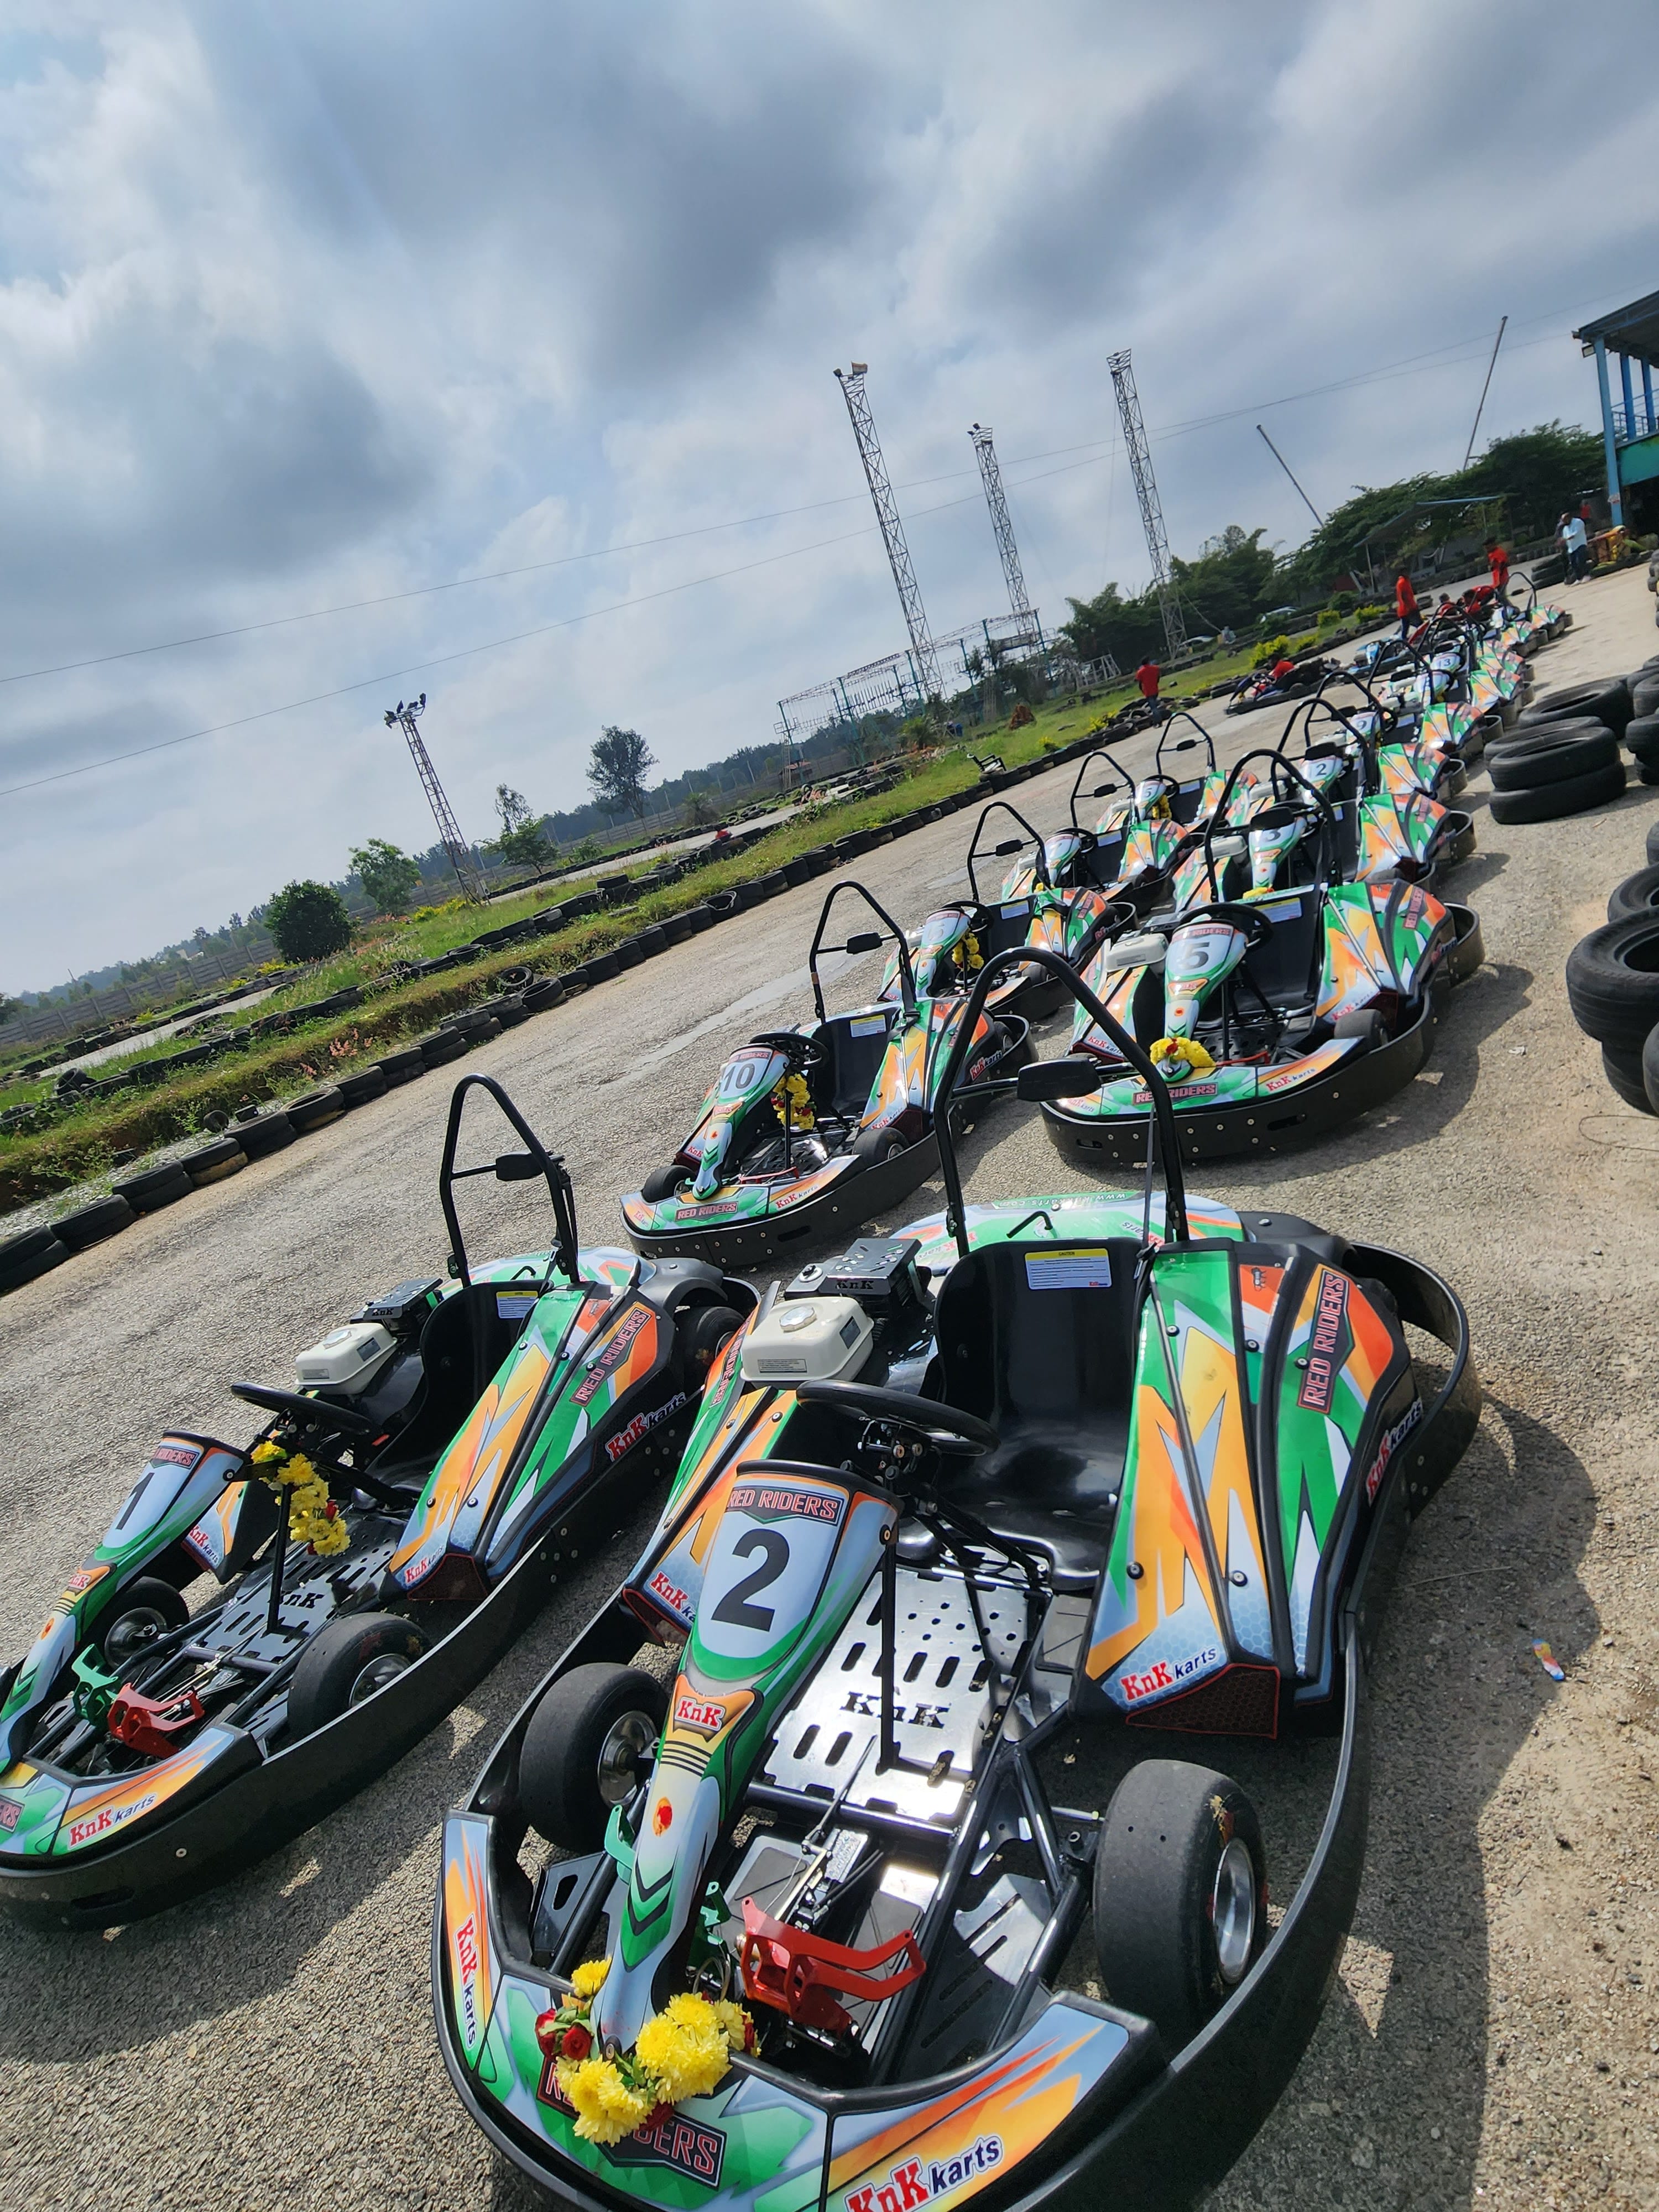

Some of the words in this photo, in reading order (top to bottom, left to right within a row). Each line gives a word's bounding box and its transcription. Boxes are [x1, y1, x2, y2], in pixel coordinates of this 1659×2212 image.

[1178, 941, 1210, 970] 5
[1088, 1036, 1107, 1048] KnK
[723, 1063, 755, 1092] 10
[1265, 1076, 1292, 1092] KnK
[1135, 1092, 1154, 1103] RE
[677, 1208, 696, 1220] RED
[698, 1202, 737, 1216] RIDERS
[775, 1193, 798, 1209] KnK
[835, 1279, 874, 1290] KnK
[1313, 1272, 1345, 1354] RIDERS
[575, 1367, 606, 1402] RED
[600, 1311, 647, 1366] RIDERS
[1302, 1358, 1332, 1406] RED
[606, 1415, 647, 1460] KnK
[647, 1394, 687, 1427] karts
[114, 1472, 155, 1531] 1
[727, 1489, 755, 1507] RED
[758, 1489, 838, 1519] RIDERS
[406, 1557, 428, 1583] KnK
[711, 1528, 790, 1632] 2
[280, 1593, 325, 1609] nK
[649, 1572, 688, 1610] KnK
[1120, 1661, 1173, 1701] KnK
[1175, 1647, 1217, 1679] karts
[677, 1699, 721, 1728] KnK
[69, 1809, 112, 1846] KnK
[114, 1794, 155, 1824] karts
[456, 1916, 479, 1985] KnK
[463, 1981, 477, 2046] karts
[931, 2140, 1000, 2195] karts
